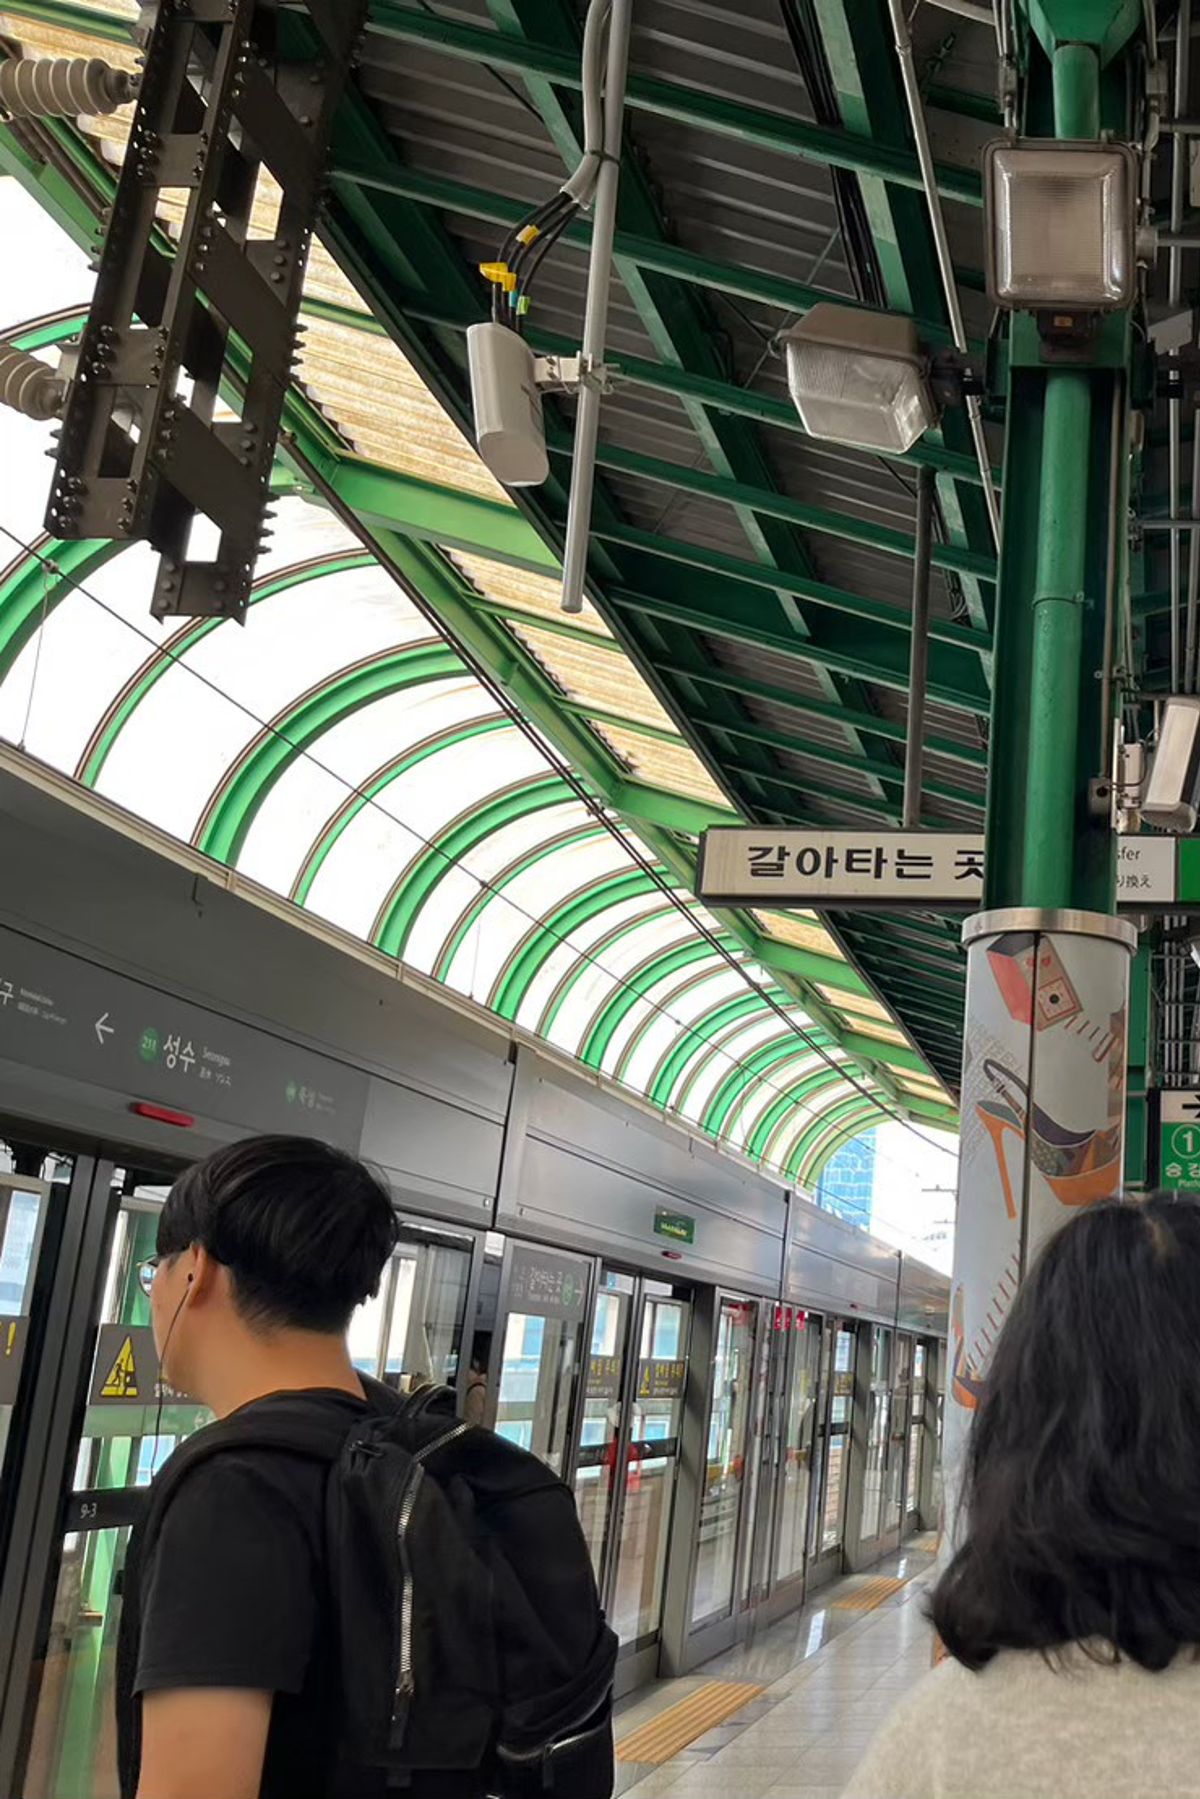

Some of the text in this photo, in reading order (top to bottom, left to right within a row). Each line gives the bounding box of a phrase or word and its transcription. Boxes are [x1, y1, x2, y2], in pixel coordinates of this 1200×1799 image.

[747, 845, 934, 880] 갈아타는
[162, 1034, 196, 1073] 성수
[80, 1502, 98, 1520] 9-3
